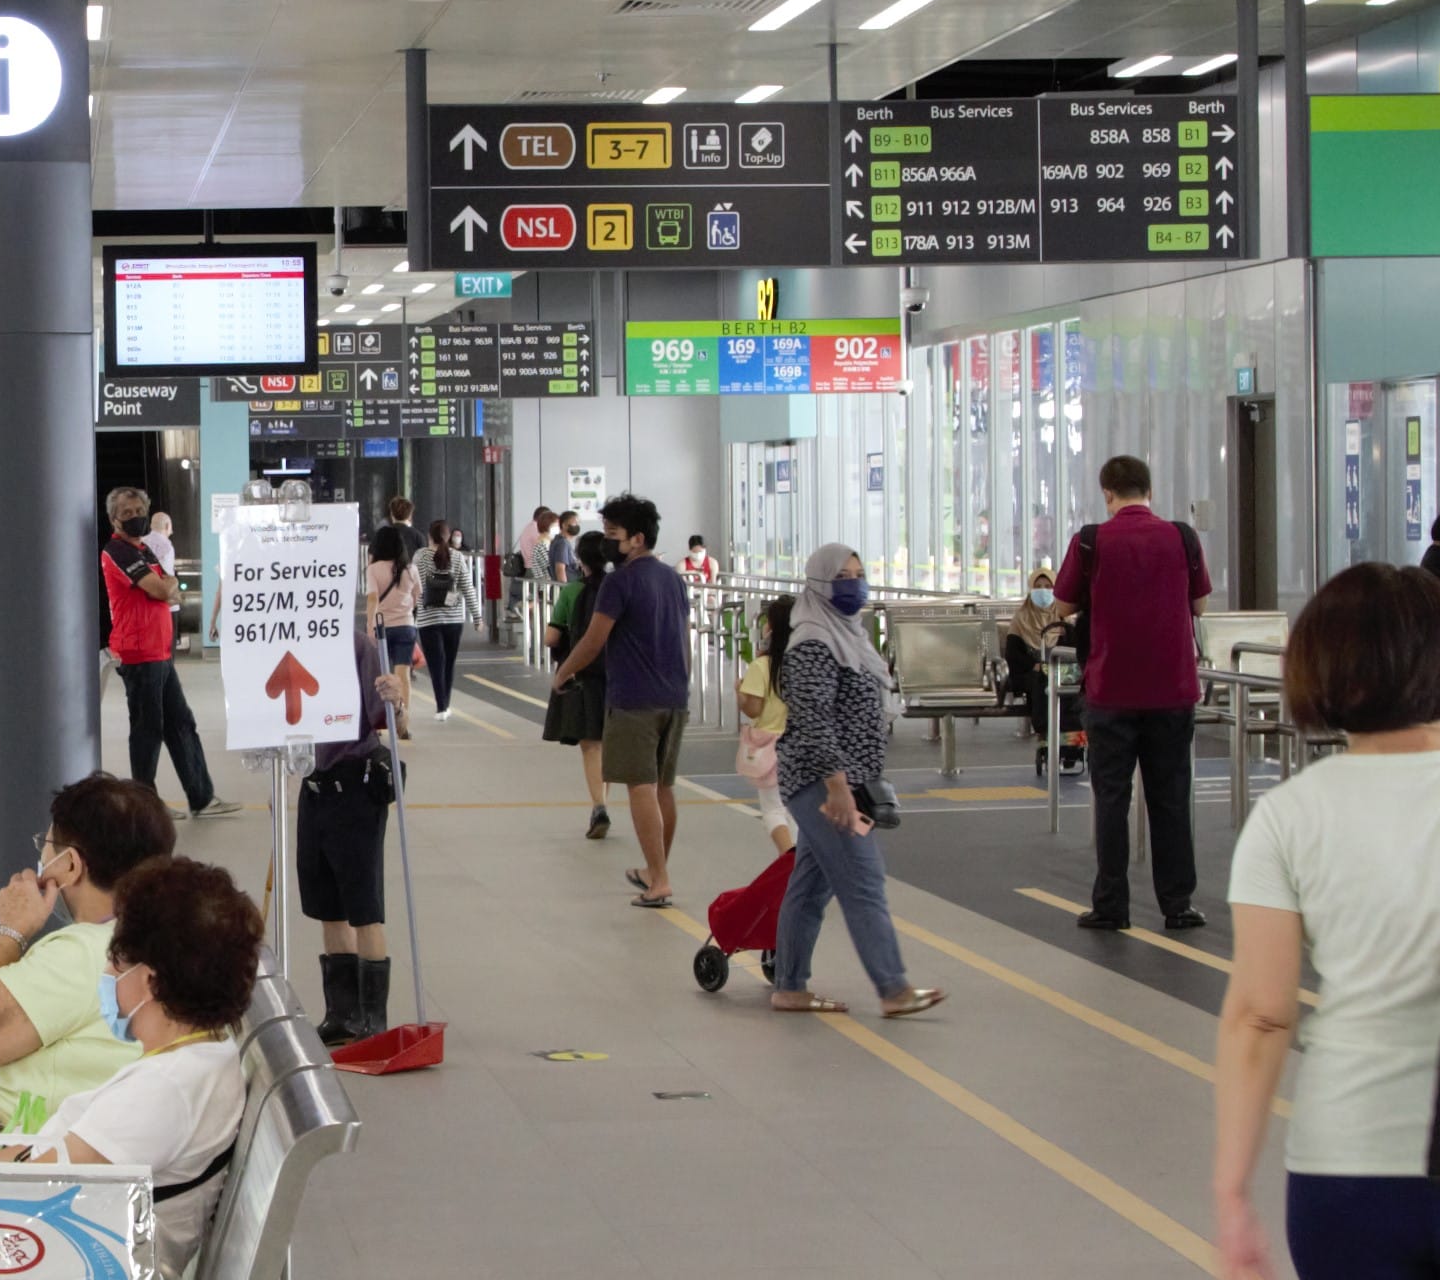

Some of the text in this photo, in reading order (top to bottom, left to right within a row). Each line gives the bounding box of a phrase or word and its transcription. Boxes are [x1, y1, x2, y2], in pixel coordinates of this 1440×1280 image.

[857, 107, 893, 120] Berth
[931, 105, 1013, 118] Bus Services
[1070, 102, 1152, 116] Bus Services
[1188, 100, 1225, 114] Berth
[1090, 128, 1200, 144] 858A 858 B1
[517, 136, 559, 156] TEL
[701, 153, 720, 163] Info
[744, 153, 781, 165] Top-Up
[874, 168, 896, 180] B11
[1042, 163, 1202, 180] 169A/B 902 969 B2
[875, 199, 1036, 216] B12 911 912 912B/M
[1050, 197, 1202, 213] 913 964 926 B3
[655, 209, 684, 220] WTBI
[517, 217, 561, 238] NSL
[603, 221, 617, 240] 2
[876, 237, 898, 249] B13
[946, 235, 974, 249] 913
[987, 234, 1030, 249] 913M
[462, 277, 494, 294] EXIT
[722, 322, 806, 335] BERTH B2
[651, 339, 693, 360] 969
[727, 339, 756, 354] 169
[773, 338, 801, 350] 169A
[835, 338, 877, 359] 902
[773, 366, 801, 377] 169B
[267, 376, 288, 387] NSL
[438, 385, 452, 393] 911
[103, 383, 177, 401] Causeway
[104, 401, 142, 415] Point
[233, 561, 347, 582] For Services
[232, 589, 344, 613] 925/M, 950,
[235, 619, 340, 643] 961/M, 965
